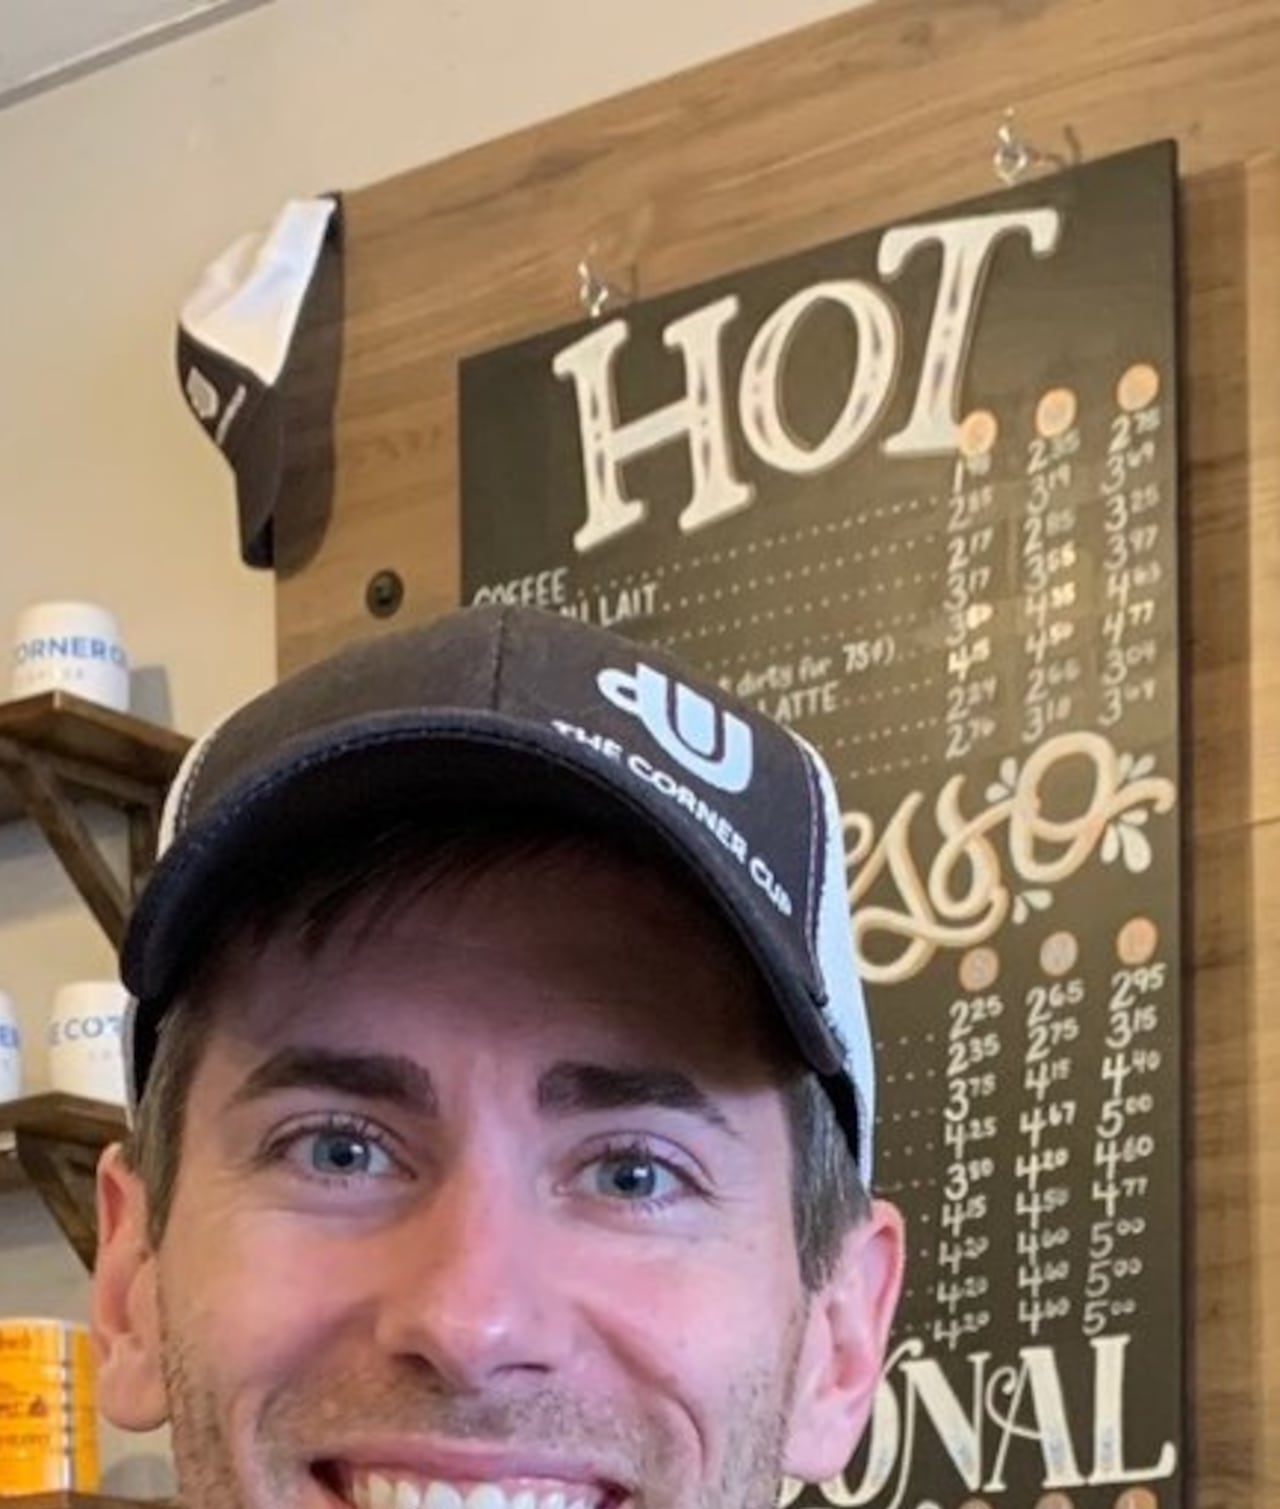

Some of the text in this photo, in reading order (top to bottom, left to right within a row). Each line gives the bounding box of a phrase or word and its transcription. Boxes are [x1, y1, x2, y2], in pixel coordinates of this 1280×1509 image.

[553, 208, 1060, 553] HOT
[599, 581, 660, 627] LAIT
[551, 718, 794, 918] THE CORNER CUP
[949, 962, 1168, 1042] 225 265 295
[946, 1004, 1159, 1077] 235 275 315
[943, 1072, 997, 1122] 375
[944, 1116, 998, 1160] 425
[1020, 1099, 1077, 1149] 467
[1091, 1175, 1149, 1219] 477
[1088, 1216, 1147, 1260] 500
[1084, 1256, 1144, 1298] 500
[1081, 1298, 1138, 1337] 500
